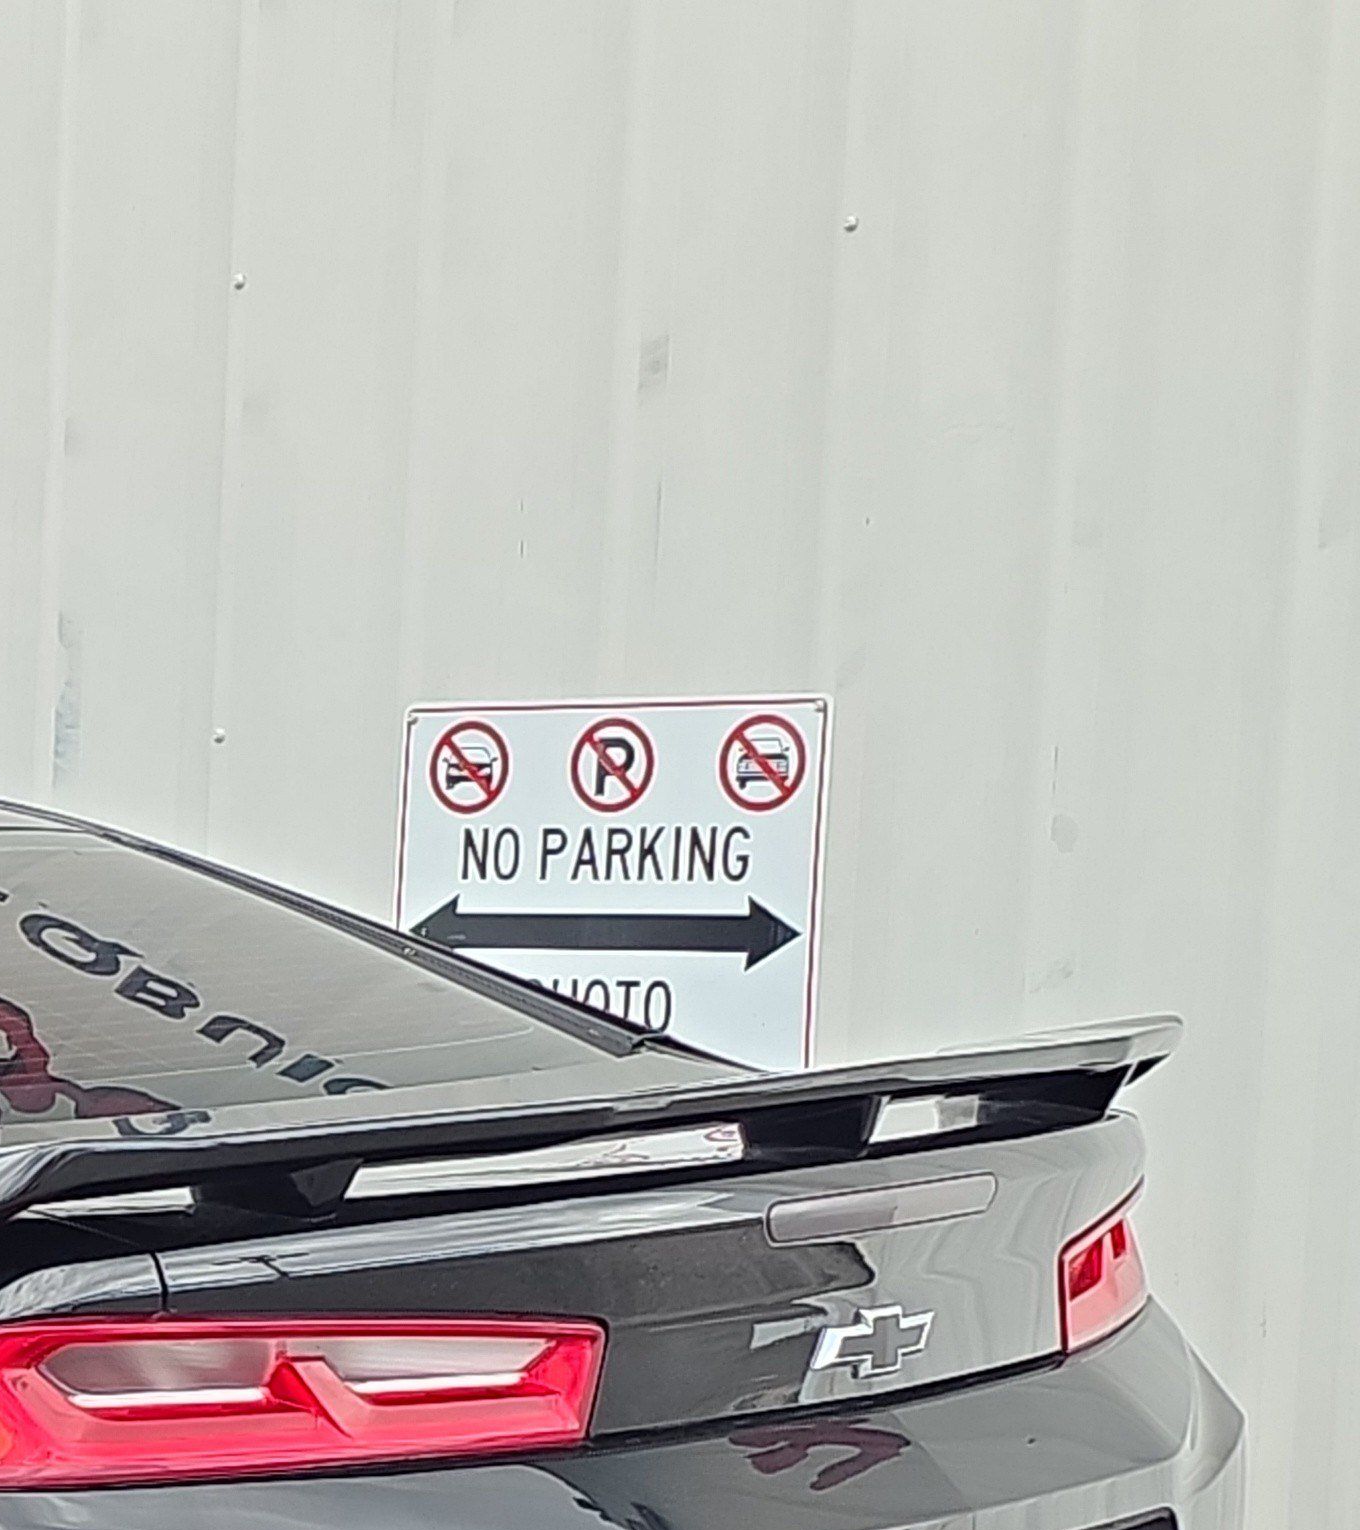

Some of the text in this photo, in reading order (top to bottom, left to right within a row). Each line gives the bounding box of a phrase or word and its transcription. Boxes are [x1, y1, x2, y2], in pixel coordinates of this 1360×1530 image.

[460, 825, 751, 881] NO PARKING
[527, 979, 673, 1034] OTO
